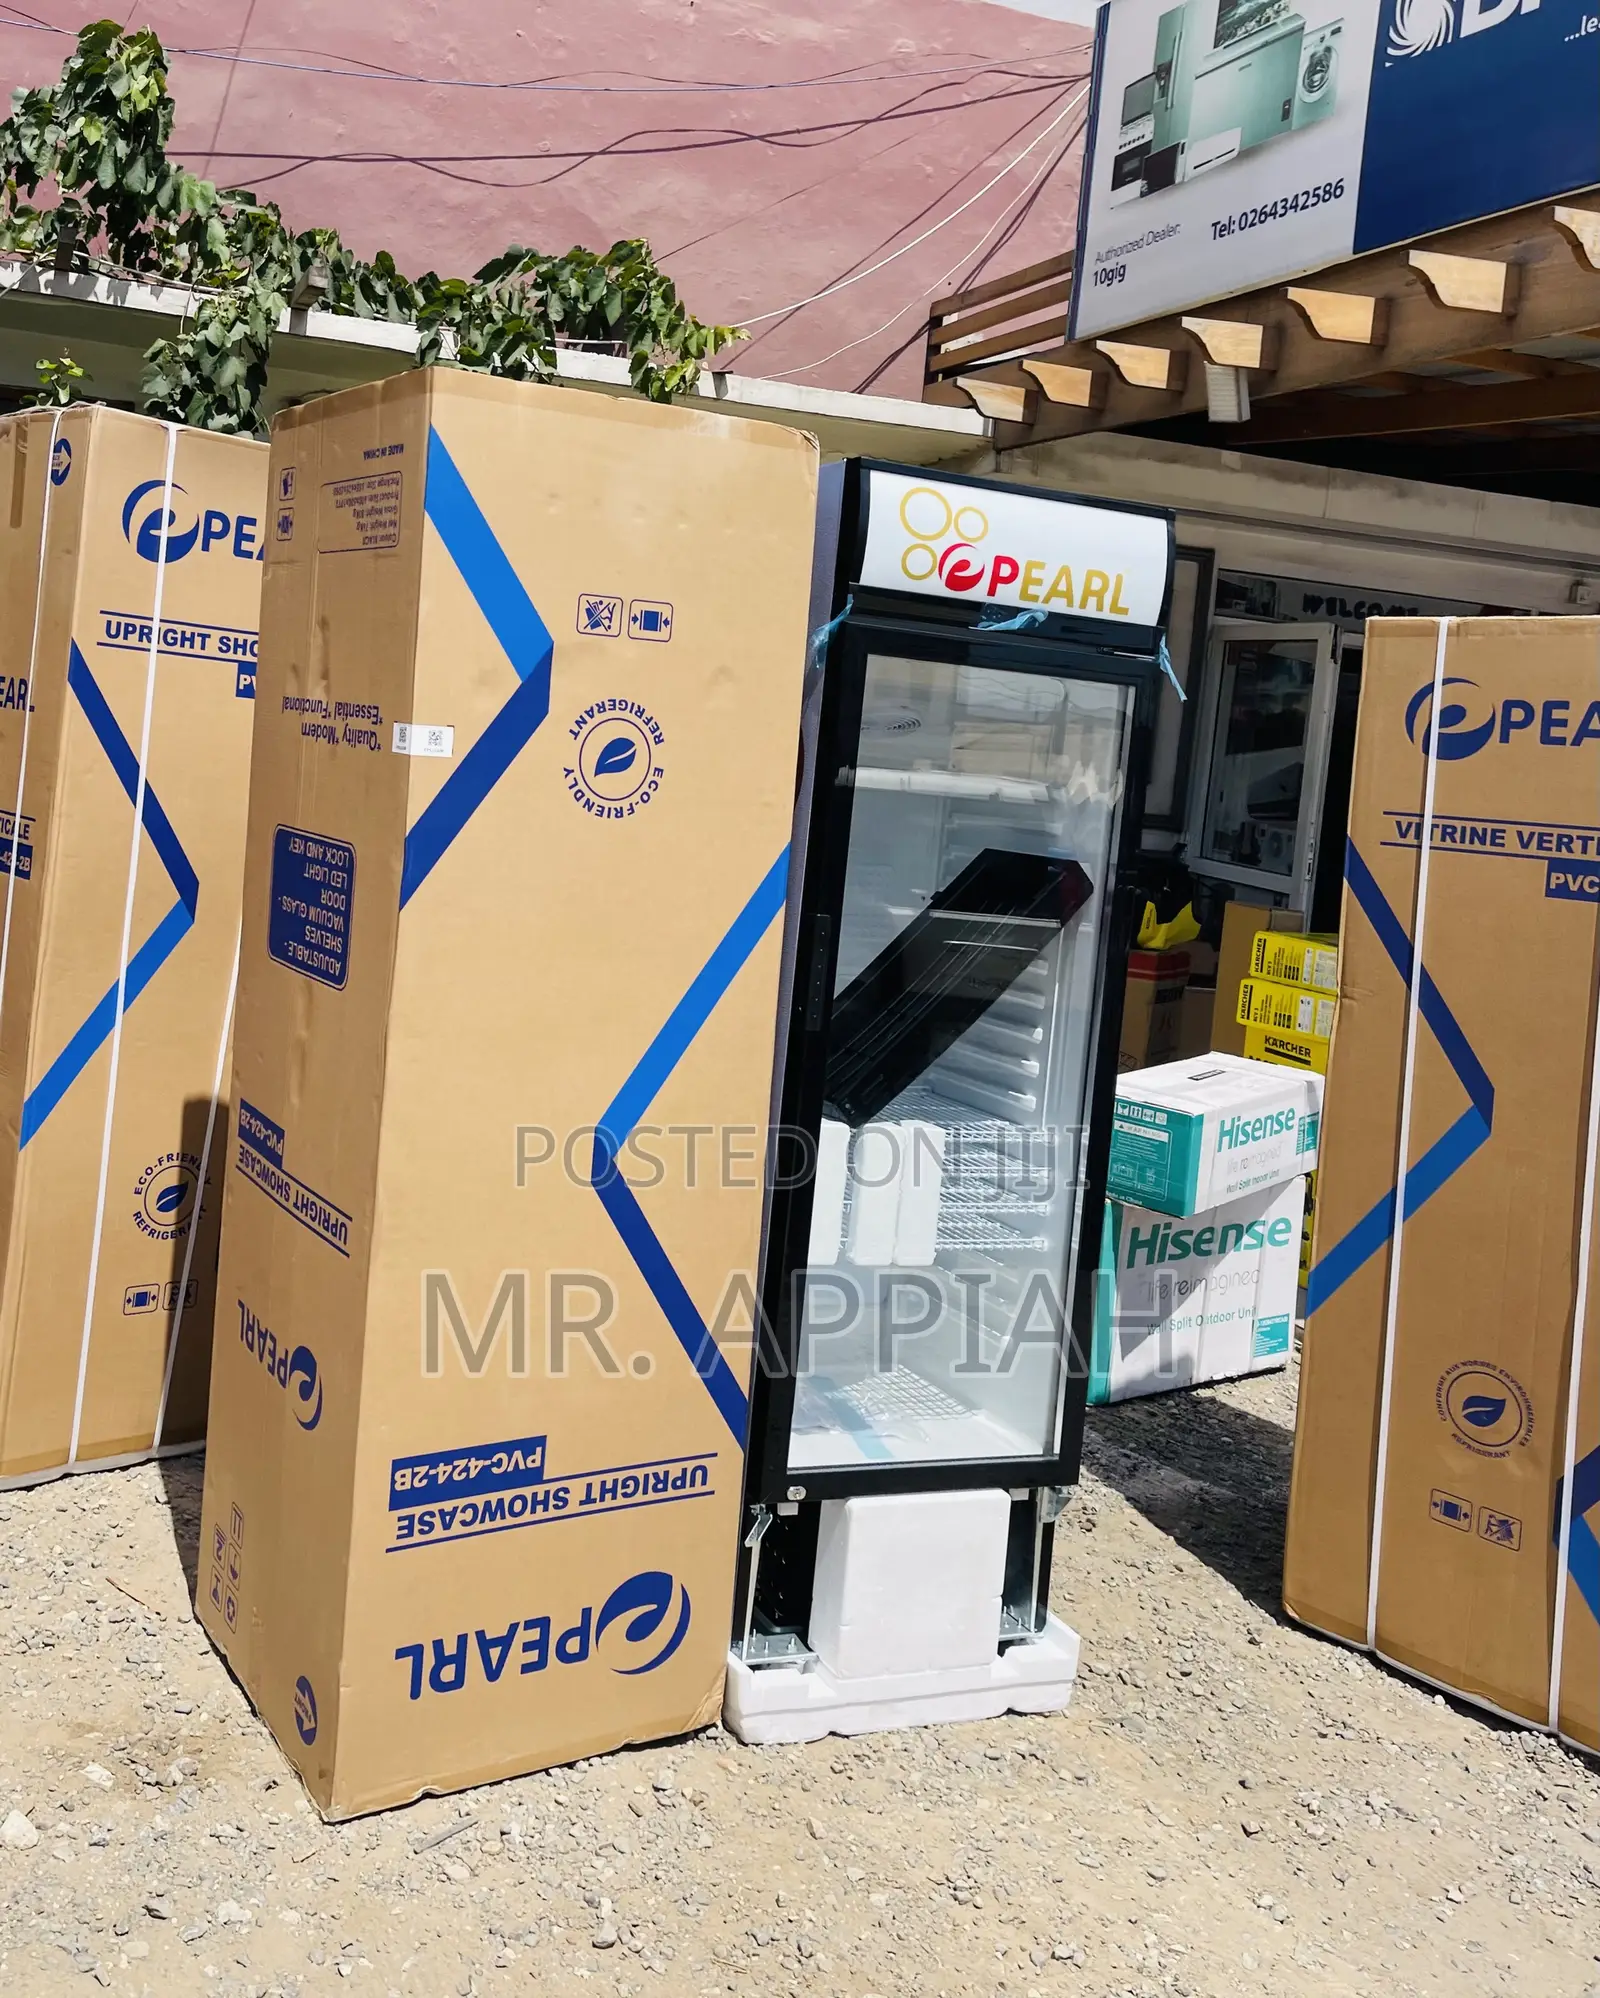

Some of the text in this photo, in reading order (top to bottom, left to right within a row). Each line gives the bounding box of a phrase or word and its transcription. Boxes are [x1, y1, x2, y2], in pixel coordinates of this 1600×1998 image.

[1212, 178, 1344, 241] Tel: 0264342586
[1095, 235, 1144, 265] Authorized
[1093, 262, 1127, 288] 10gig
[201, 508, 265, 561] PE
[986, 554, 1130, 616] PEARL
[569, 698, 665, 746] REFRIGERANT
[563, 767, 665, 819] ECO-FRIENDLY
[288, 836, 350, 868] LOCK AND KEY
[303, 862, 348, 889] LED LIGHT
[308, 904, 344, 933] VACUUM
[321, 888, 346, 911] DOOR
[305, 925, 343, 954] SHELVES
[240, 1108, 284, 1156] PVC-424-2B
[1217, 1107, 1296, 1153] Hisense
[239, 1144, 348, 1246] UPRIGHT SHOWCASE
[1126, 1216, 1293, 1270] Hisense
[237, 1298, 289, 1389] PEARL
[1169, 1315, 1193, 1332] Split
[1435, 1374, 1448, 1423] CONFORME
[393, 1446, 543, 1492] PVC-424-2B
[396, 1464, 709, 1540] UPRIGHT SHOWCASE
[395, 1606, 593, 1701] PEARL
